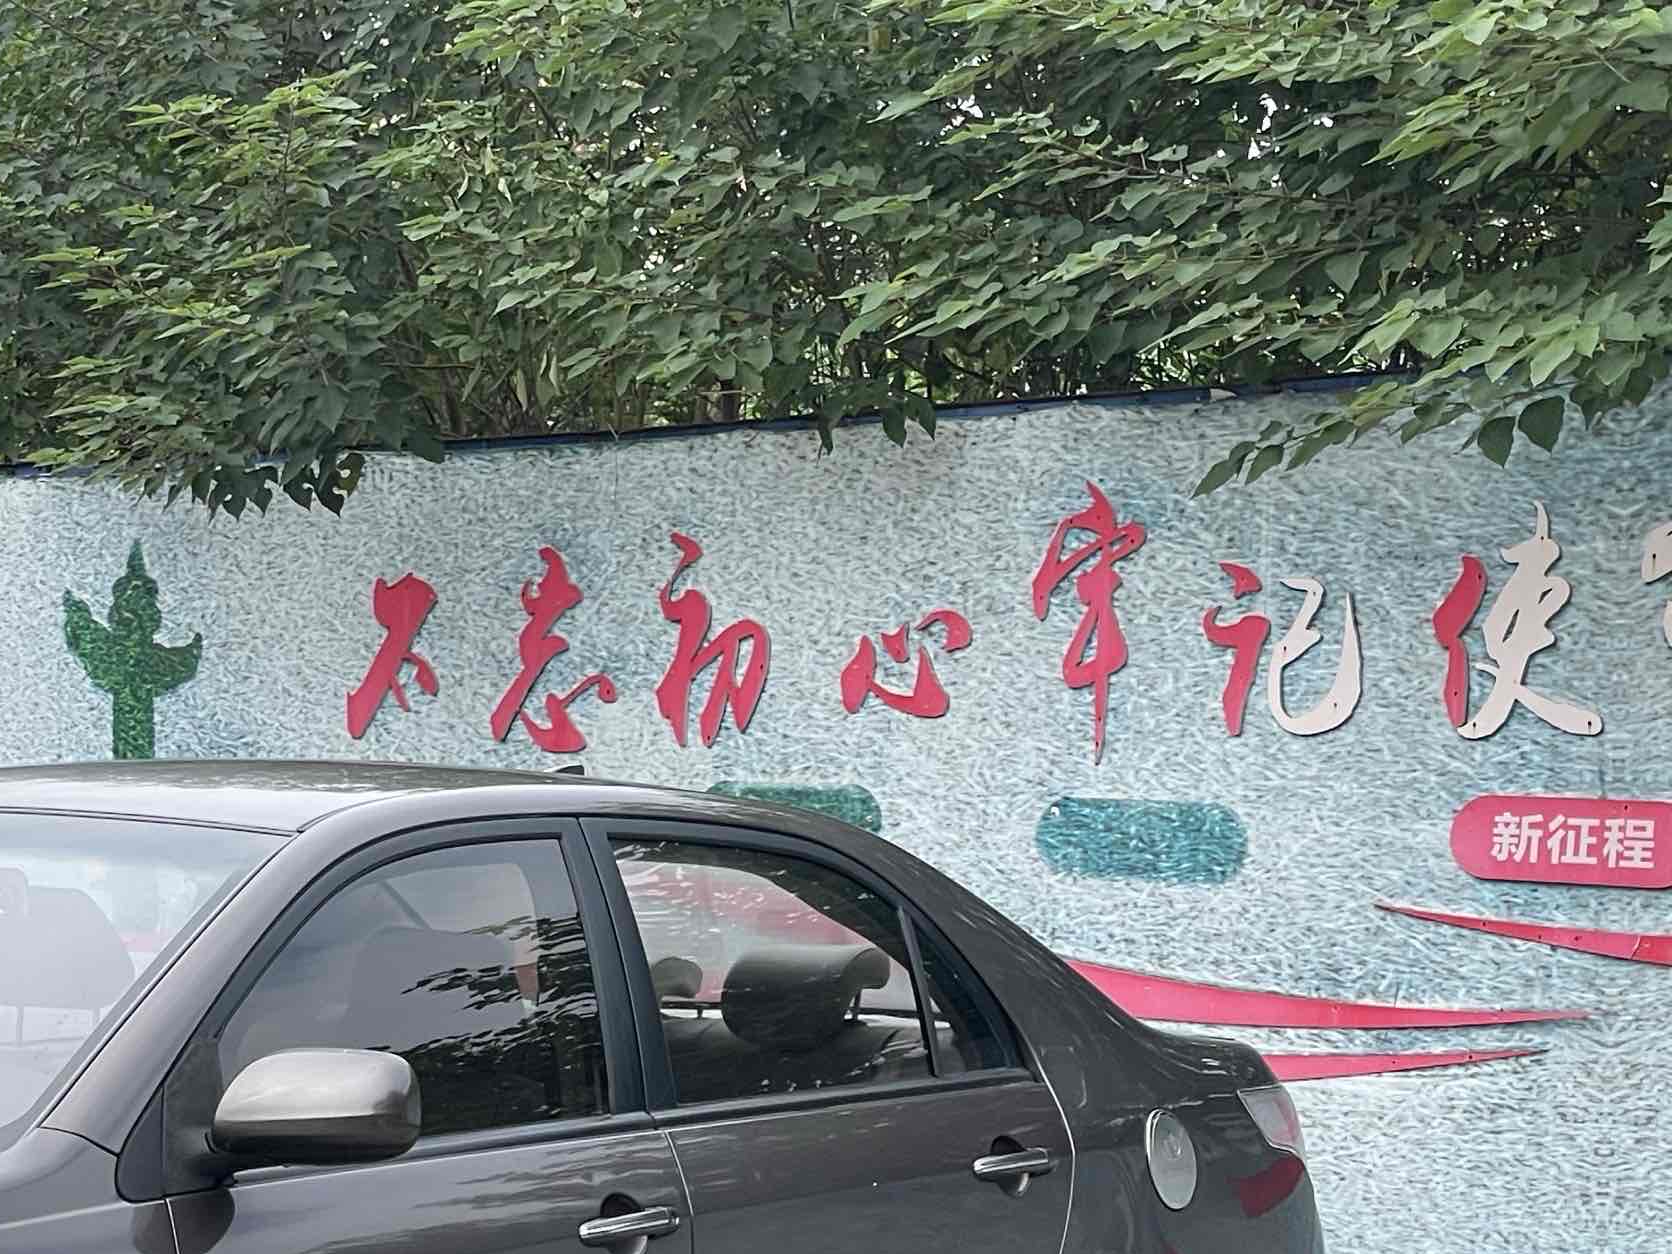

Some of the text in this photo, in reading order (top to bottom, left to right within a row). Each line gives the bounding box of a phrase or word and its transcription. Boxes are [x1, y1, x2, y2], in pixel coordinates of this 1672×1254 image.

[346, 480, 1672, 766] 不忘初心牢记使
[1491, 812, 1655, 869] 新征程
